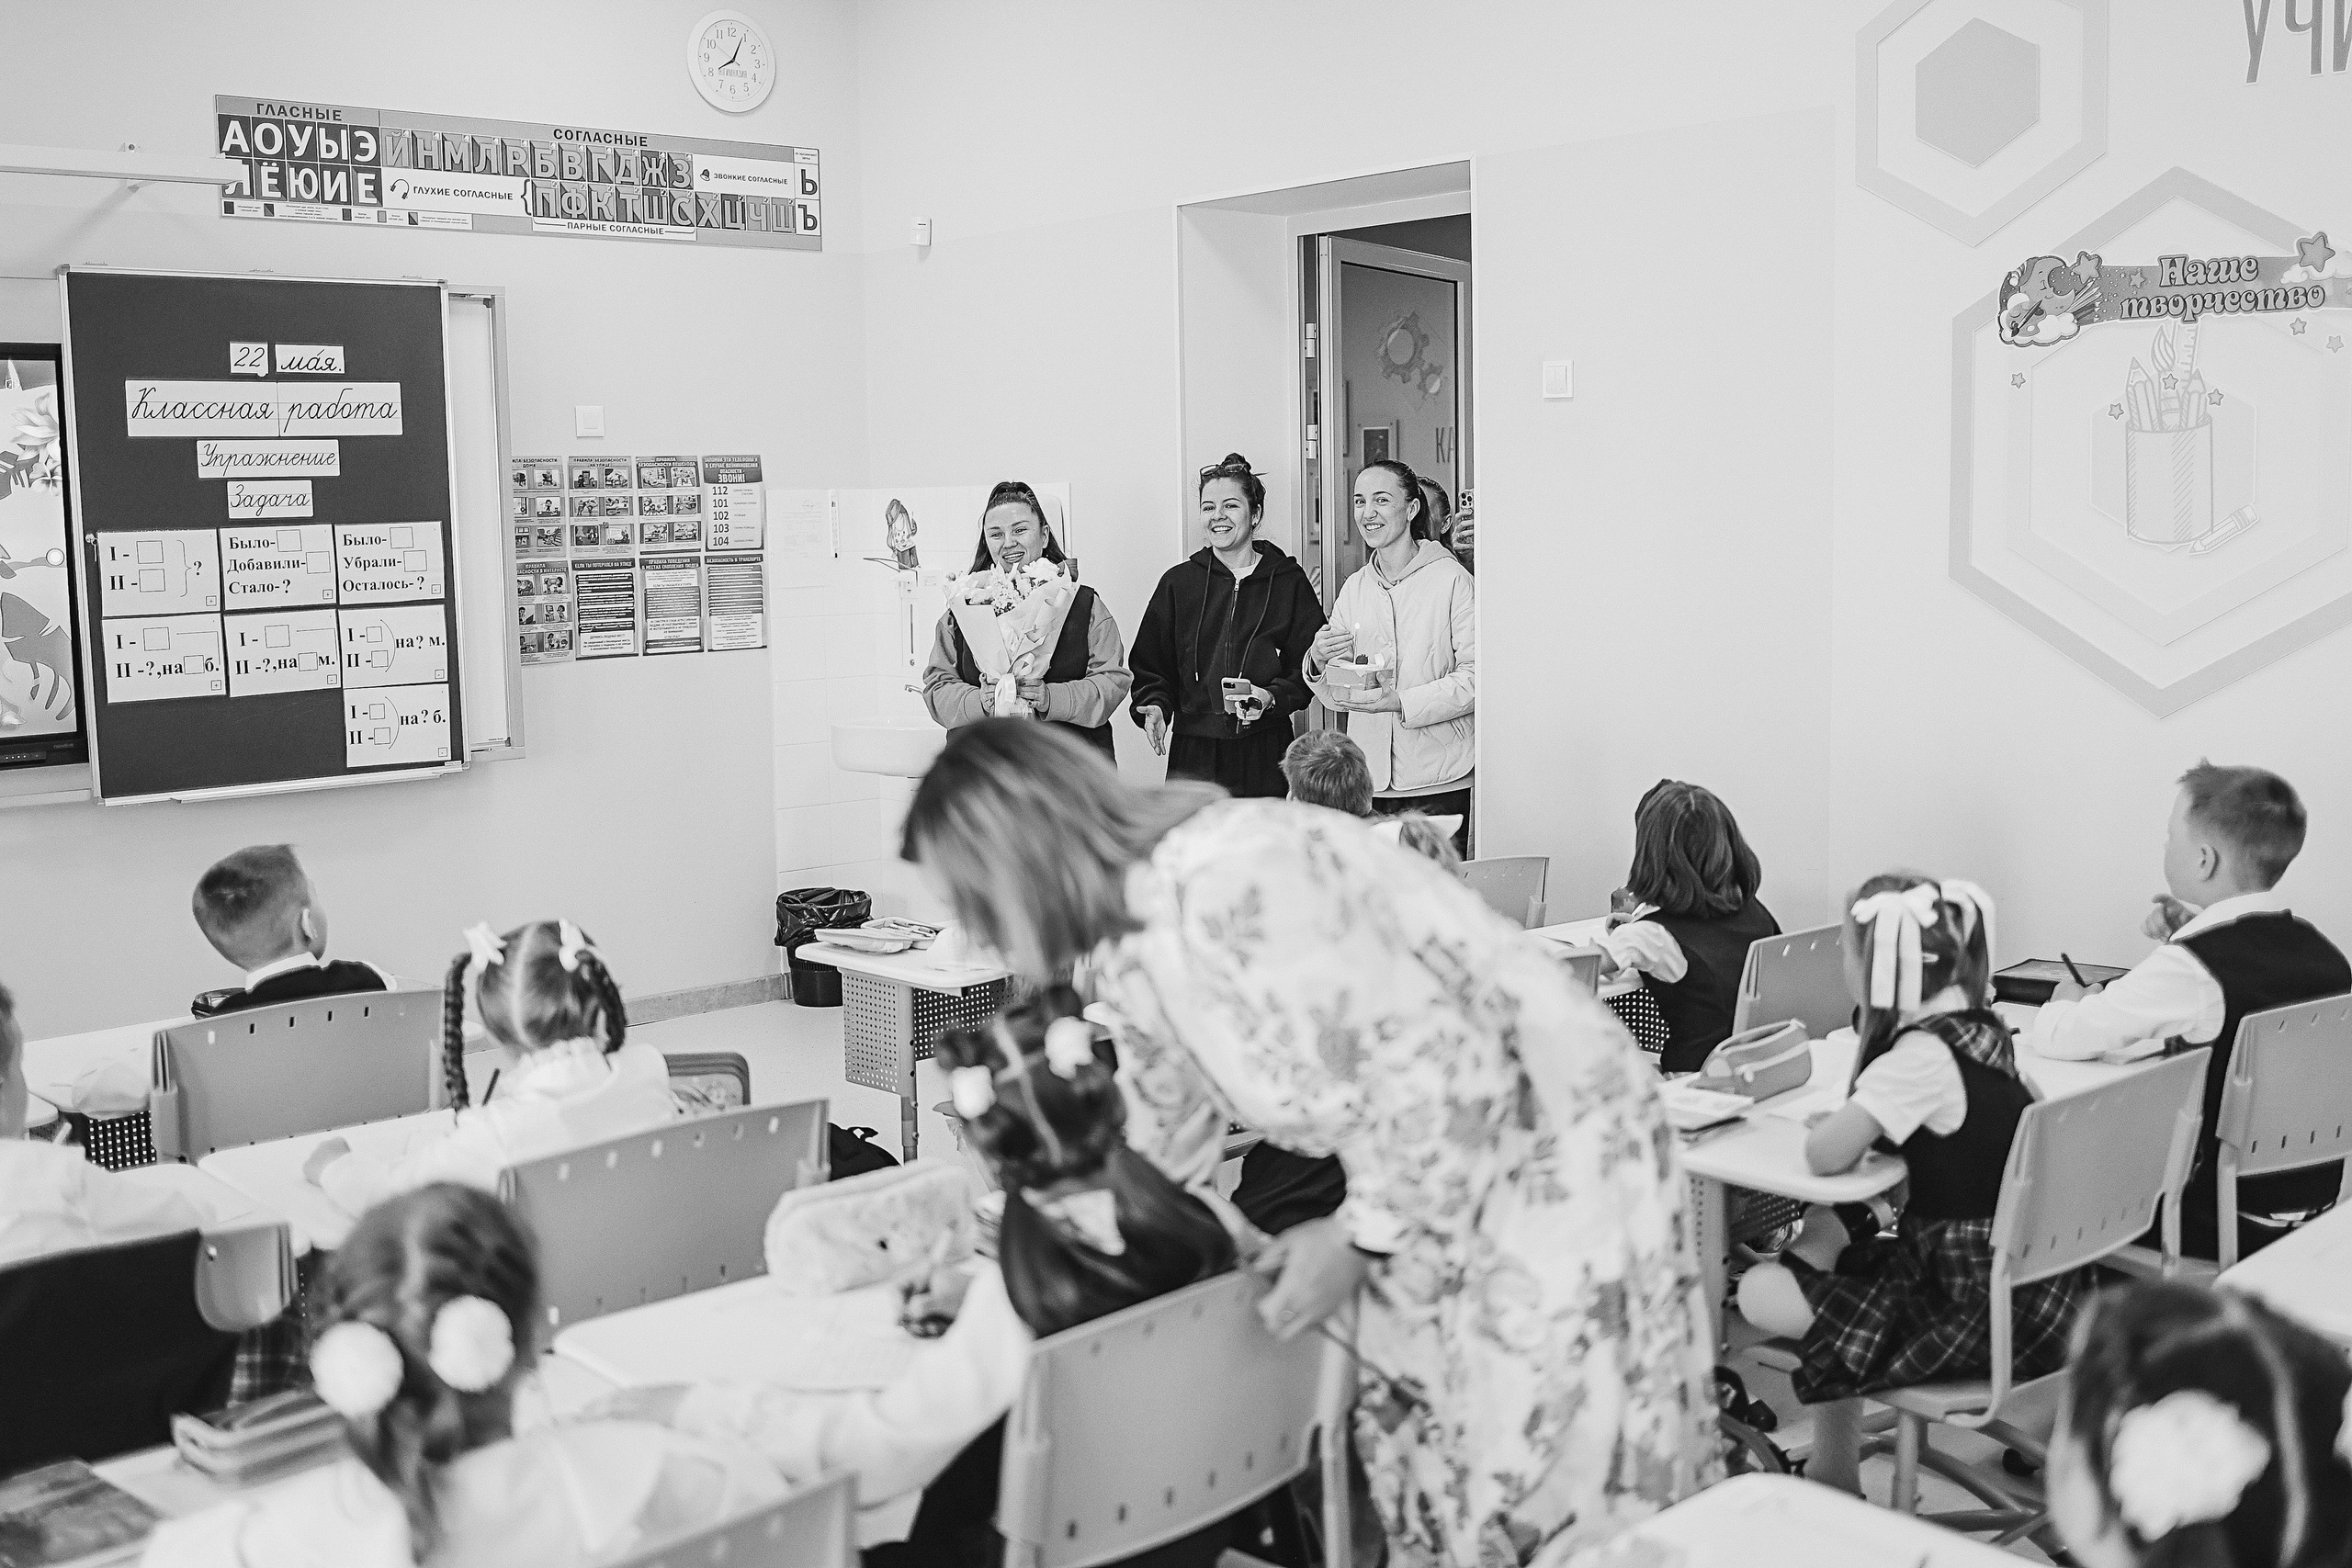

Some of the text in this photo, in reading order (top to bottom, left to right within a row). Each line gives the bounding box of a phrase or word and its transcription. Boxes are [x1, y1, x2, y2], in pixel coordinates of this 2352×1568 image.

[256, 103, 342, 121] ГЛАСНЫЕ
[553, 129, 648, 147] СОГЛАСНЫЕ
[713, 173, 788, 185] ЗВОНКИЕ СОГЛАСНЫЕ
[800, 168, 818, 195] Ь
[413, 186, 513, 200] ГЛУХИЕ СОГЛАСНЫЕ
[797, 204, 818, 231] Ъ
[567, 221, 664, 235] ПАРНЫЕ СОГЛАСНЫЕ
[2158, 255, 2259, 287] Наше
[2120, 285, 2326, 322] творчество
[234, 346, 265, 367] 22
[131, 387, 398, 434] Классная работа
[200, 443, 336, 477] Упражнение
[718, 473, 745, 483] ЗВОНИ!
[712, 486, 729, 495] 112
[230, 484, 310, 516] Задача
[712, 499, 729, 508] 101
[713, 511, 729, 521] 102
[713, 524, 729, 534] 103
[712, 536, 729, 547] 104
